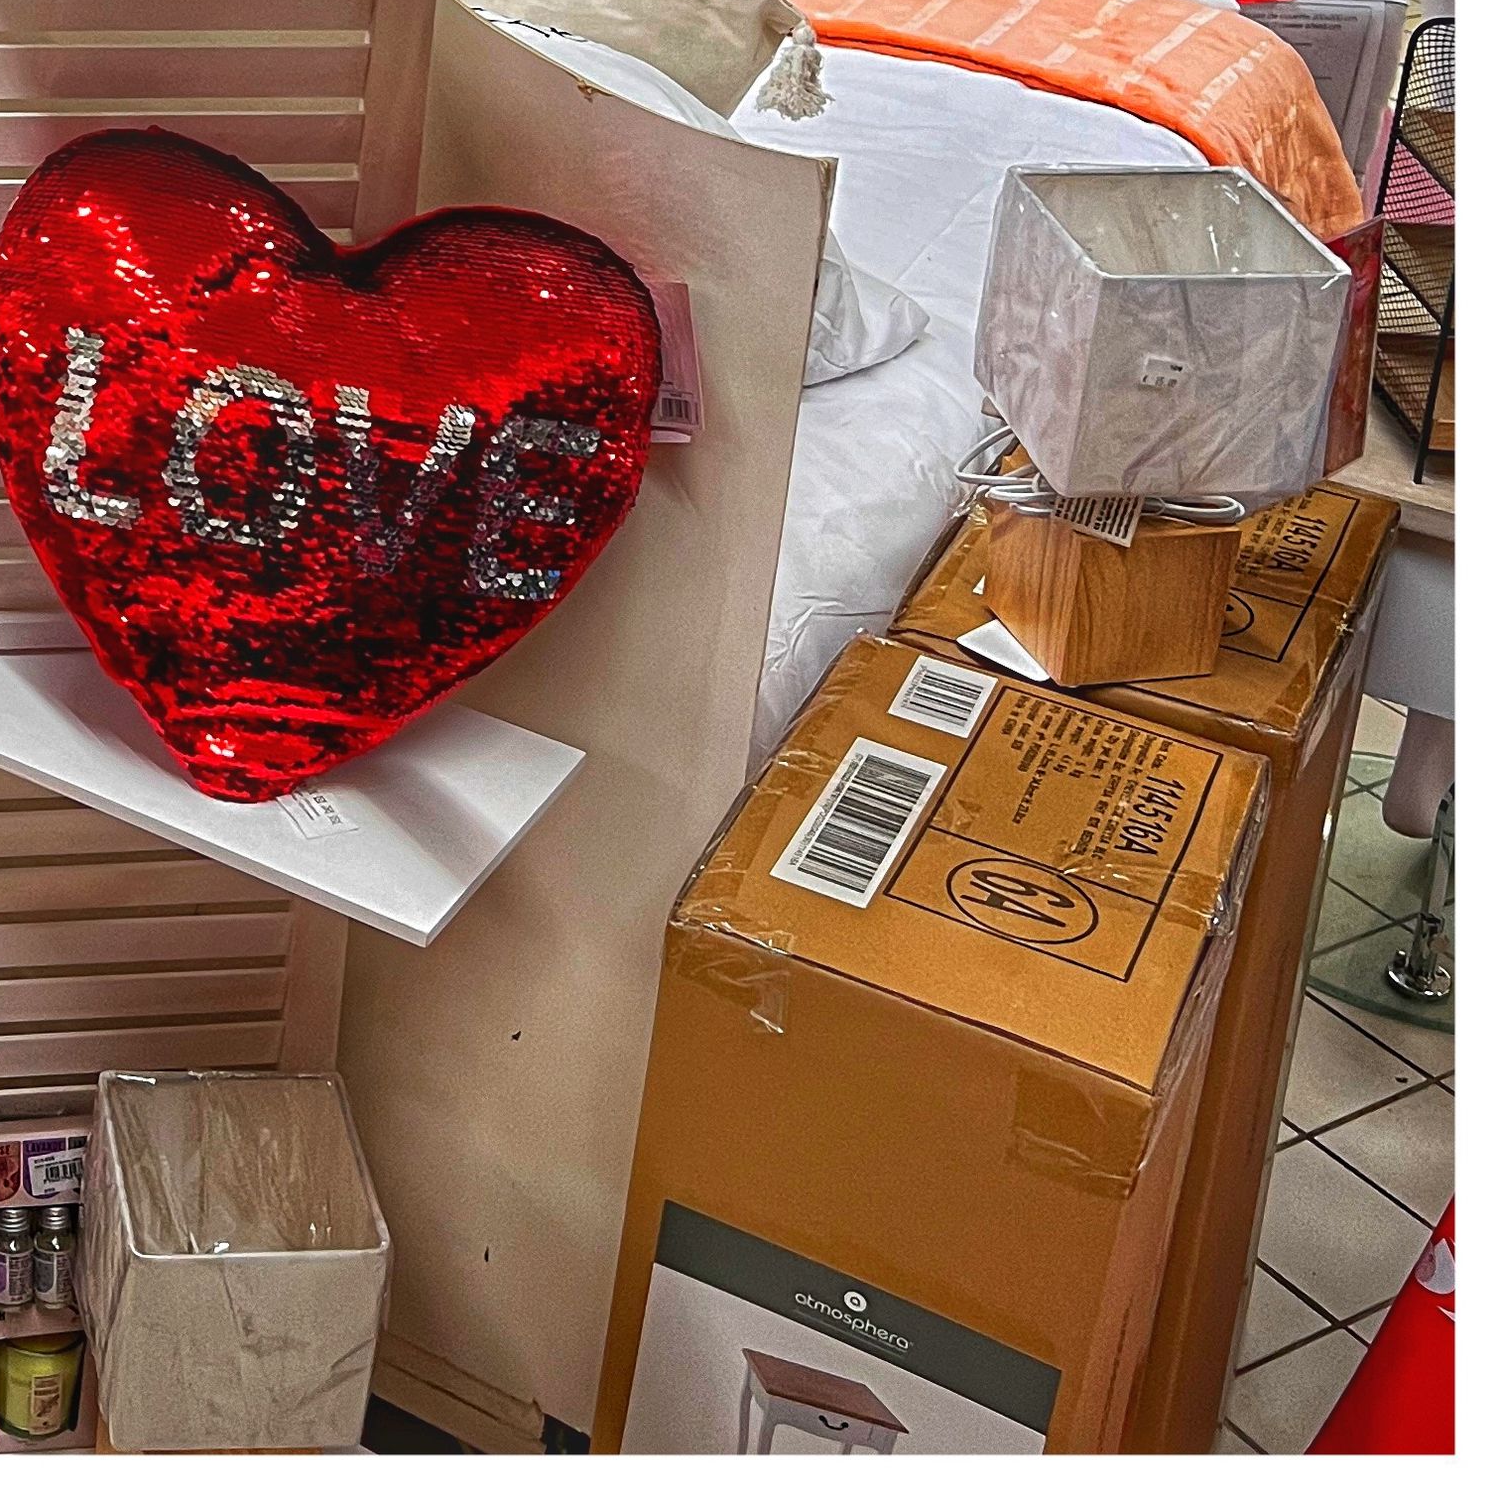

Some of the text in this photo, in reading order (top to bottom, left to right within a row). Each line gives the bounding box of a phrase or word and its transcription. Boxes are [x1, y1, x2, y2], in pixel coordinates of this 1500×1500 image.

[42, 326, 600, 600] LOVE
[1267, 515, 1328, 572] 114516A
[1114, 775, 1185, 856] 114516A
[959, 868, 1076, 929] 6A
[795, 1292, 909, 1350] atmosphera
